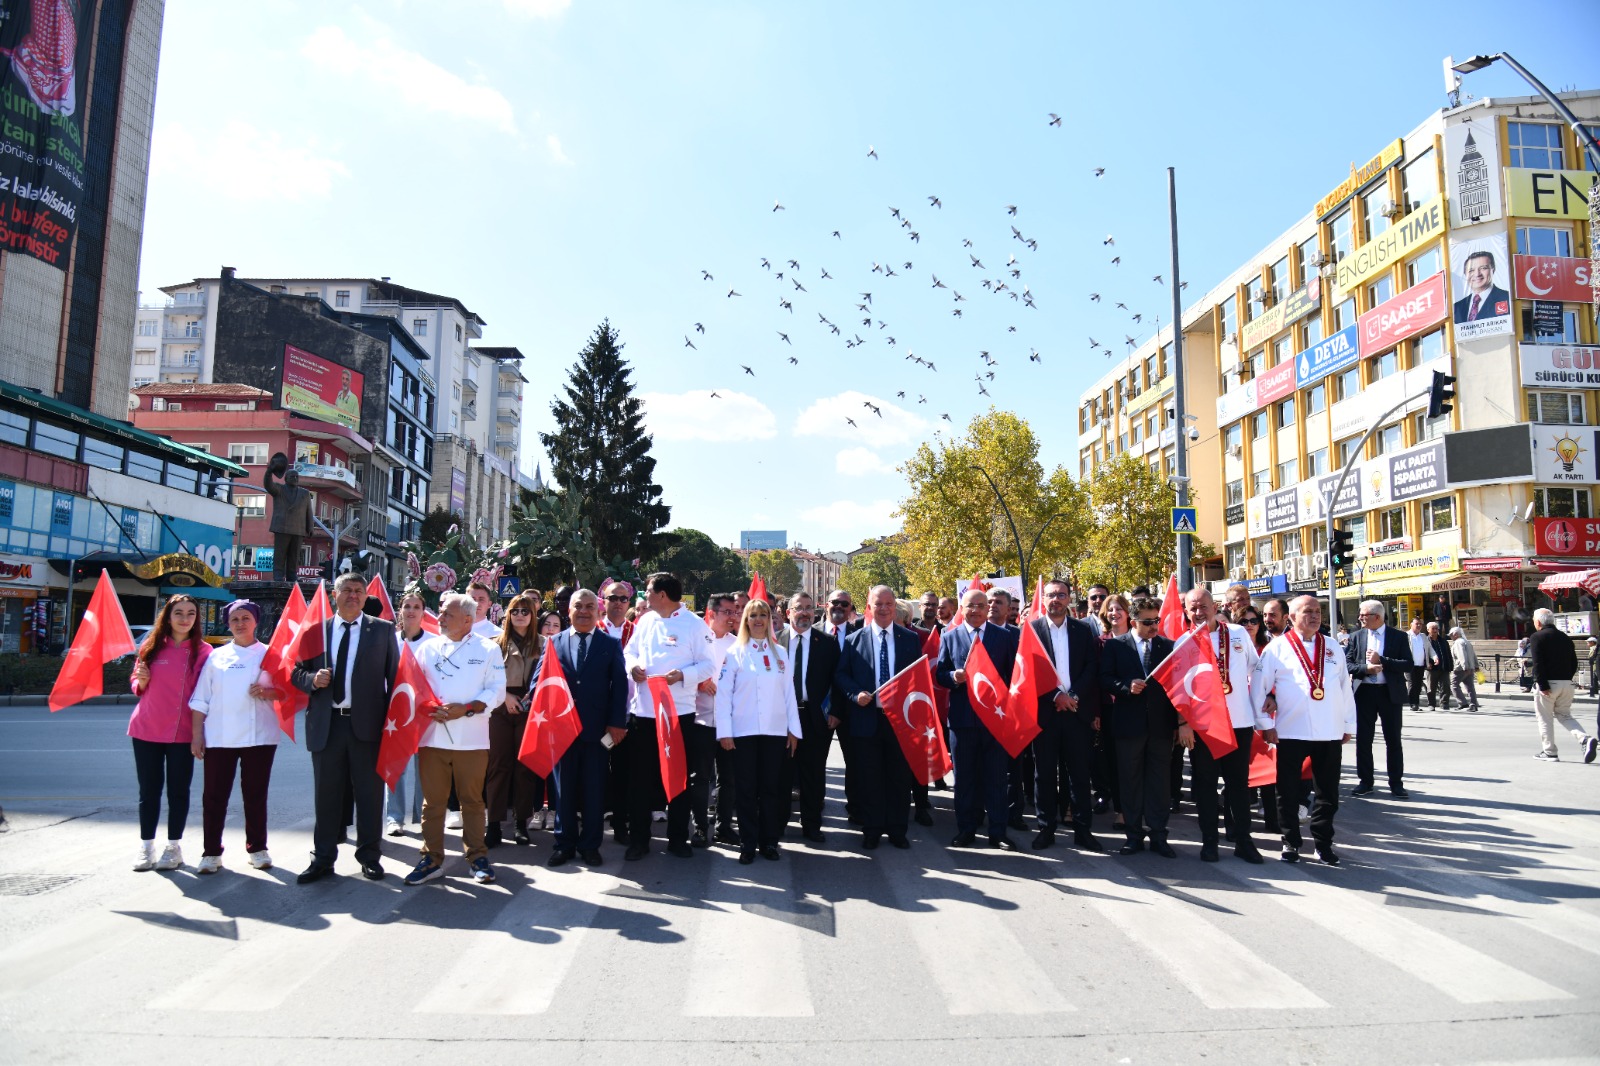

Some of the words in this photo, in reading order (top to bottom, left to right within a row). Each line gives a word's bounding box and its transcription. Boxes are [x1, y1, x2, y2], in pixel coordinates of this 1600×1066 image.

[1357, 155, 1382, 184] TIME
[1339, 232, 1397, 288] ENGLISH
[1399, 204, 1439, 247] TIME
[1381, 290, 1434, 332] SAADET
[1461, 323, 1485, 331] MAHMUT
[1487, 319, 1508, 327] ARIKAN
[1315, 333, 1350, 365] DEVA
[1266, 368, 1291, 390] SAADET
[1535, 370, 1584, 382] SÜRÜCÜ
[1394, 459, 1407, 472] AK
[1408, 448, 1436, 468] PARTİ
[1322, 480, 1334, 492] AK
[1334, 471, 1358, 488] PRTİ
[1394, 465, 1436, 486] ISPARTA
[0, 487, 13, 498] 101
[1401, 479, 1437, 495] BAŞKANLIĞI
[1268, 499, 1277, 509] AK
[1278, 490, 1295, 504] PARTİ
[1268, 504, 1296, 520] ISPARTA
[1368, 560, 1397, 573] OSMANCIK
[1398, 555, 1433, 569] KURUYEMİŞ
